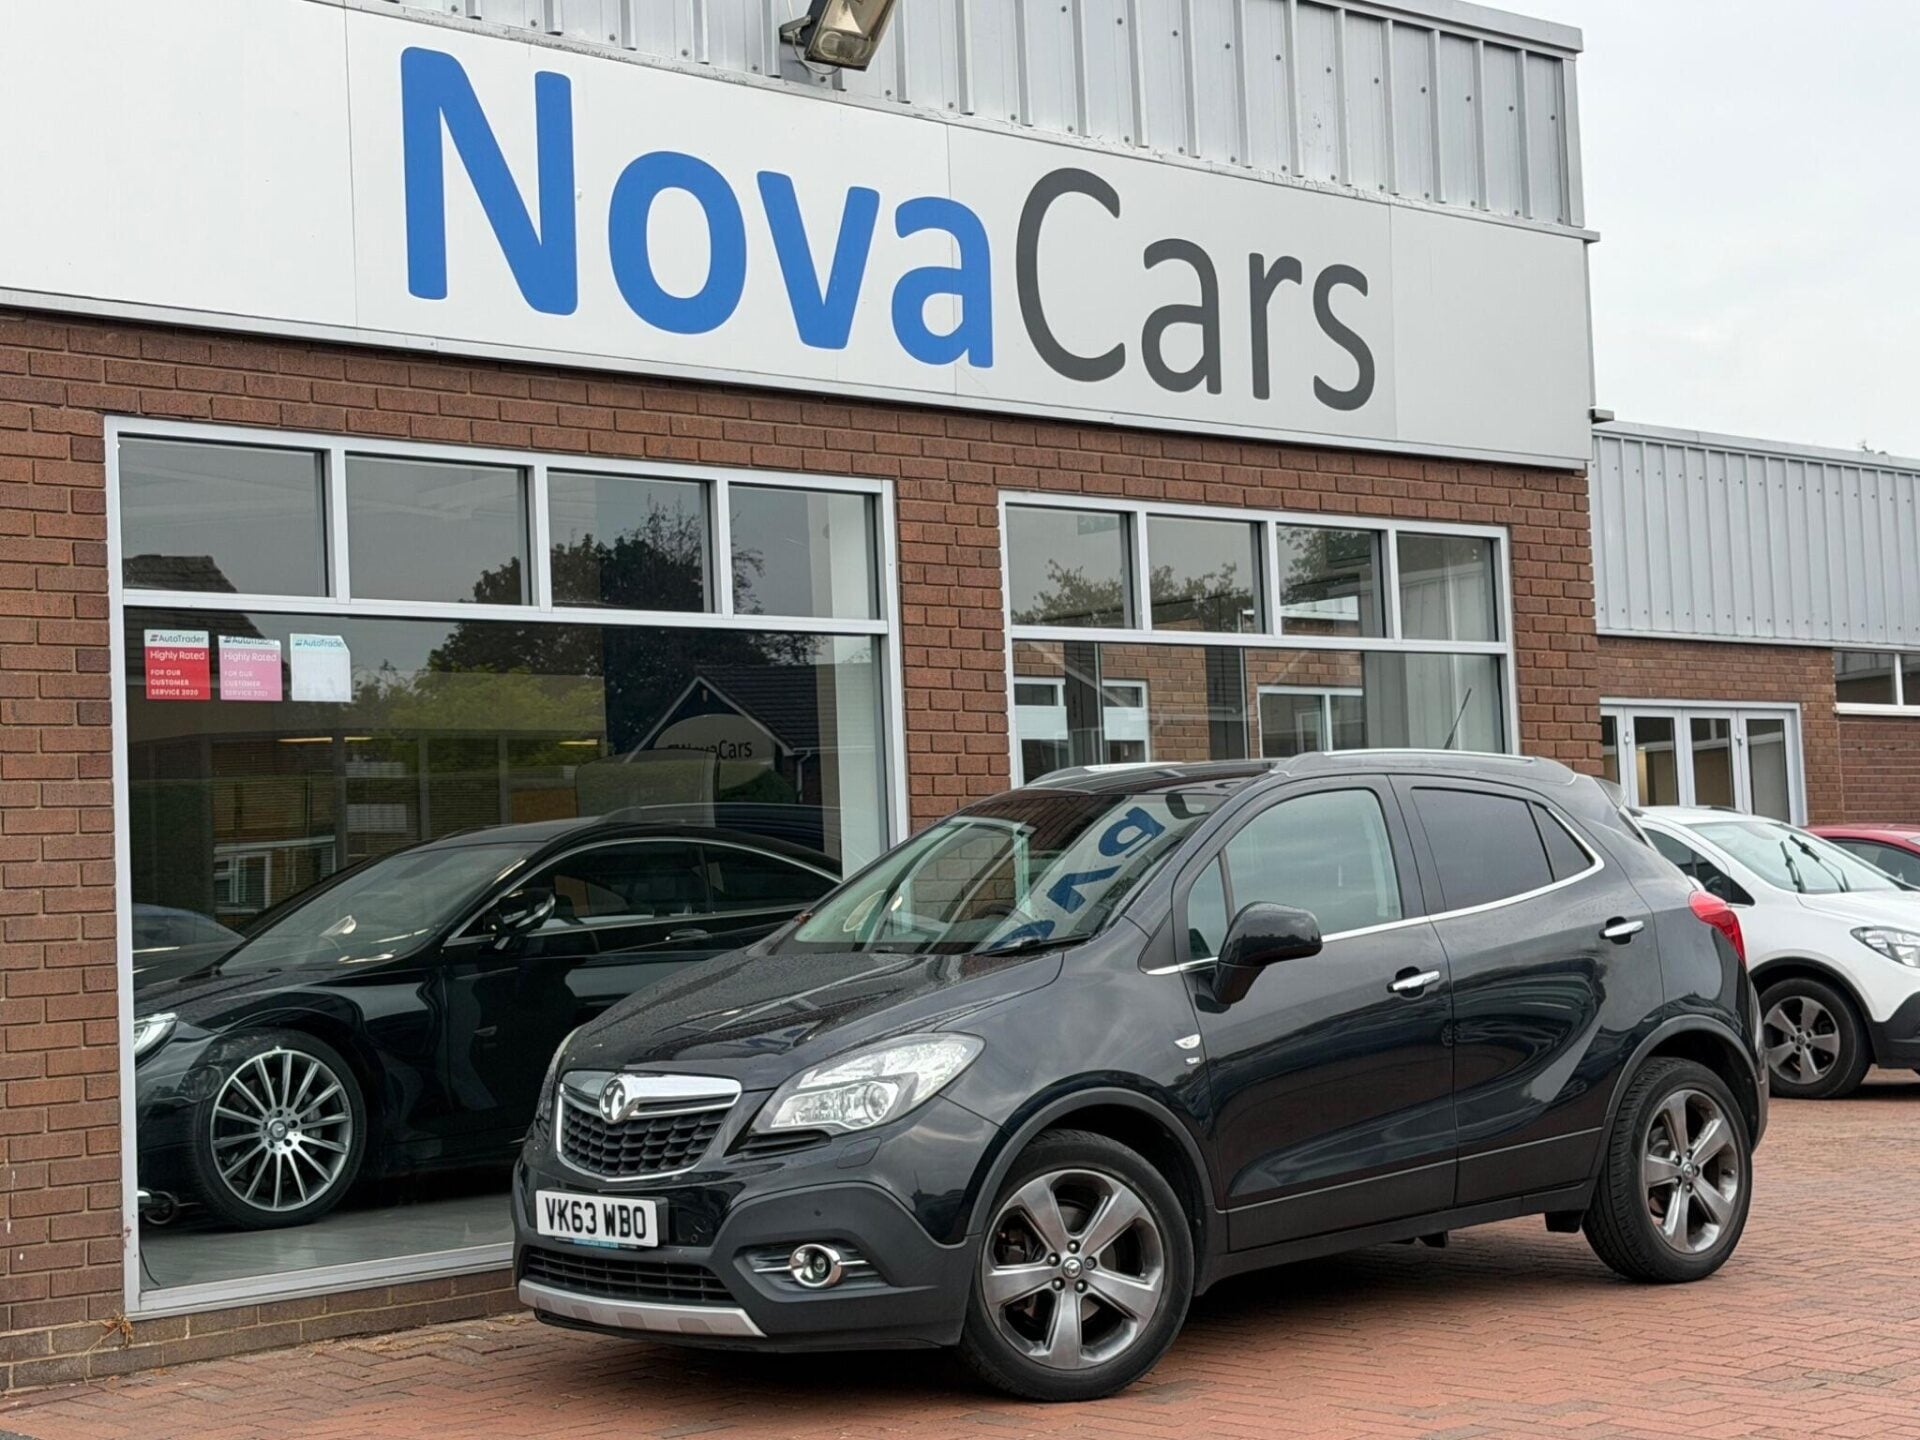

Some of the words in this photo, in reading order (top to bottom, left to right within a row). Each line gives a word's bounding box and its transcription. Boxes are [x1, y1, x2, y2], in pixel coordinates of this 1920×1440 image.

[401, 47, 1375, 411] NovaCars
[158, 634, 205, 643] AutoTrader
[150, 650, 178, 661] Highly
[179, 651, 205, 660] Rated
[224, 652, 250, 662] Highly
[252, 653, 277, 662] Rated
[150, 668, 164, 676] FOR
[166, 668, 181, 676] OUR
[150, 678, 189, 686] CUSTOMER
[151, 688, 180, 696] SERVICE
[545, 1197, 597, 1234] VK63
[603, 1203, 647, 1240] WBO
